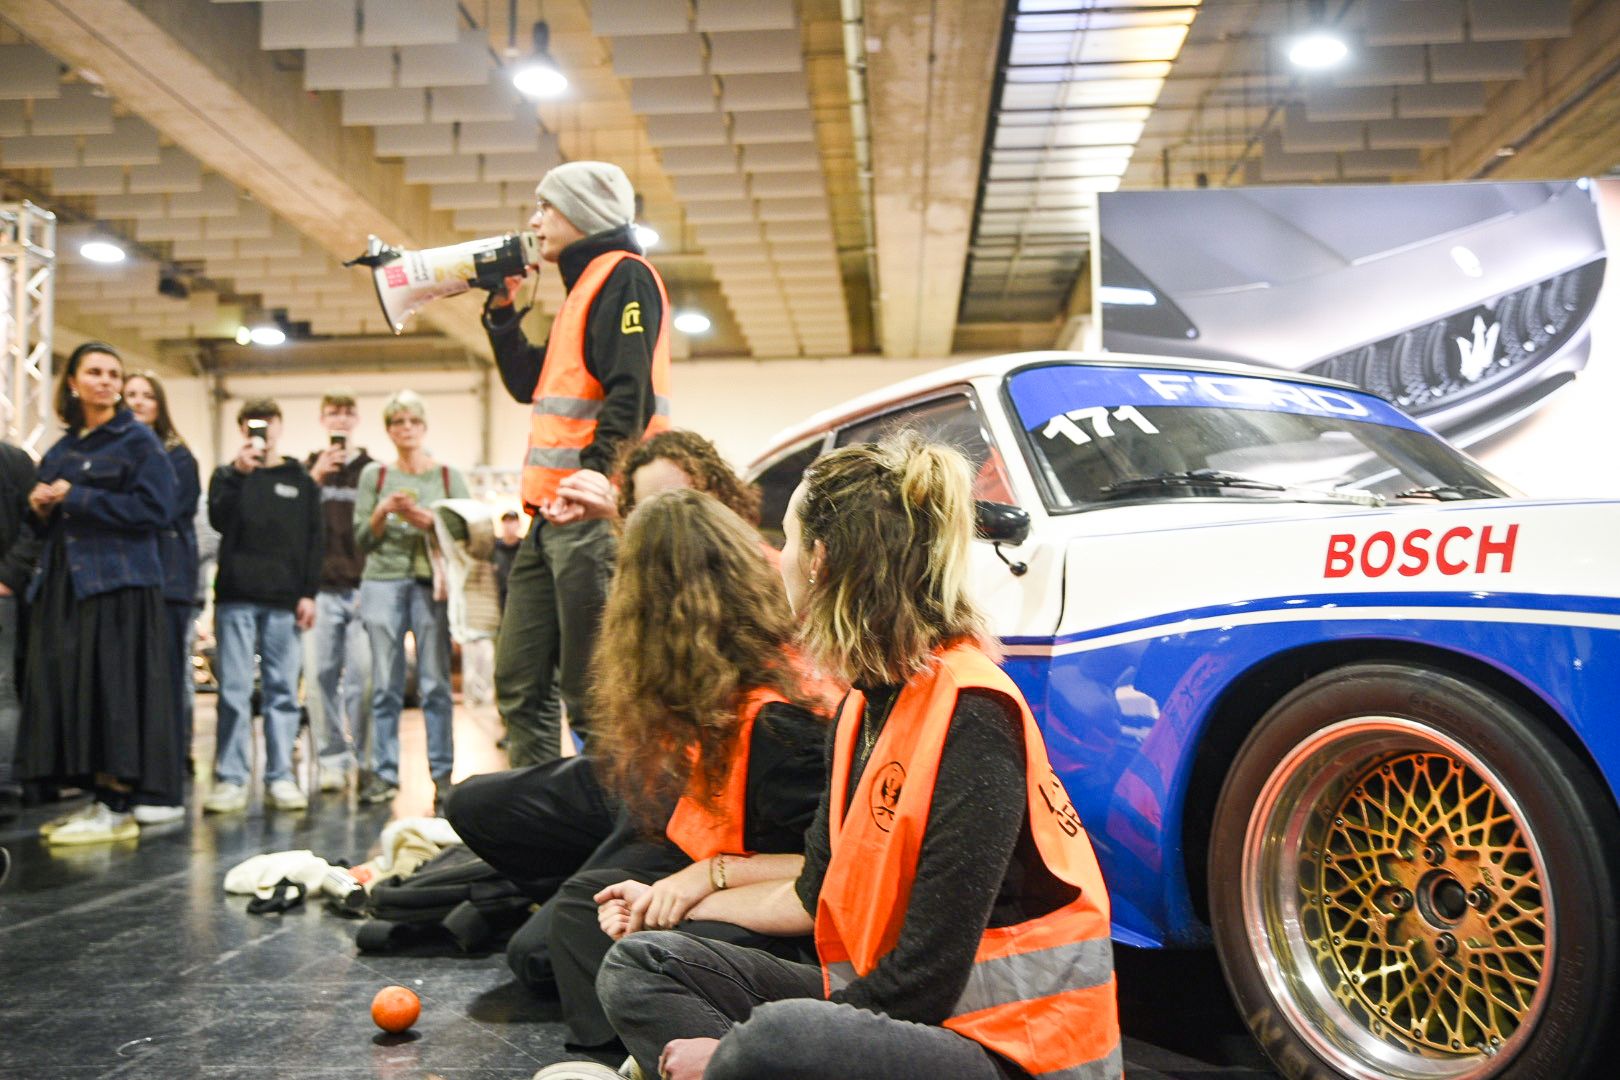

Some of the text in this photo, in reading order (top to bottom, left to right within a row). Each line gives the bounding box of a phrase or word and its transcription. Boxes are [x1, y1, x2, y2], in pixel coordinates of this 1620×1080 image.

[1138, 373, 1369, 417] FORD
[1042, 405, 1160, 445] 171
[1323, 524, 1519, 578] BOSCH
